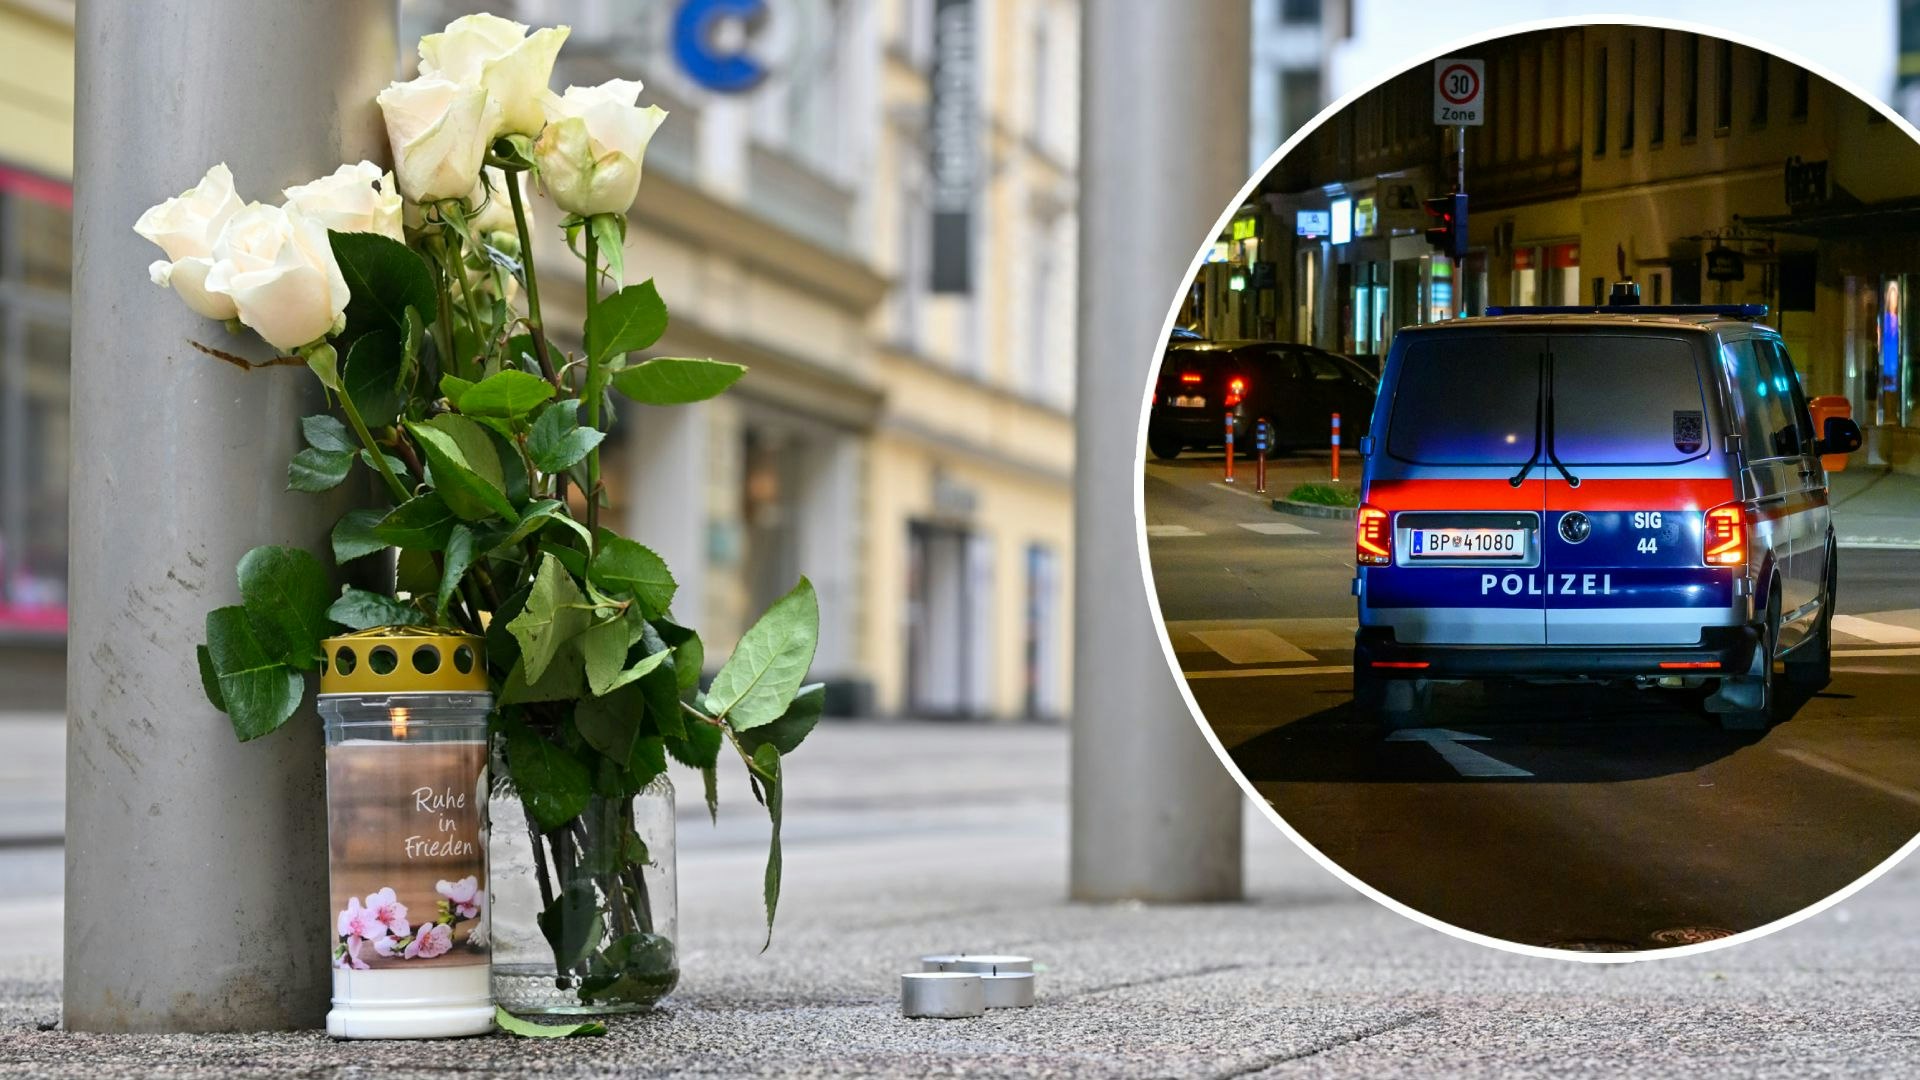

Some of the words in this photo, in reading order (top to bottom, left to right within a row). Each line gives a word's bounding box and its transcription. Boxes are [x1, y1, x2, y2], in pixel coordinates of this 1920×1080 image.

[1450, 75, 1469, 94] 30
[1442, 107, 1476, 121] Zone
[1634, 511, 1662, 529] SIG
[1637, 537, 1658, 554] 44
[1481, 574, 1611, 595] POLIZEI
[411, 786, 465, 813] Ruhe
[439, 812, 457, 832] in
[404, 834, 473, 859] Frieden
